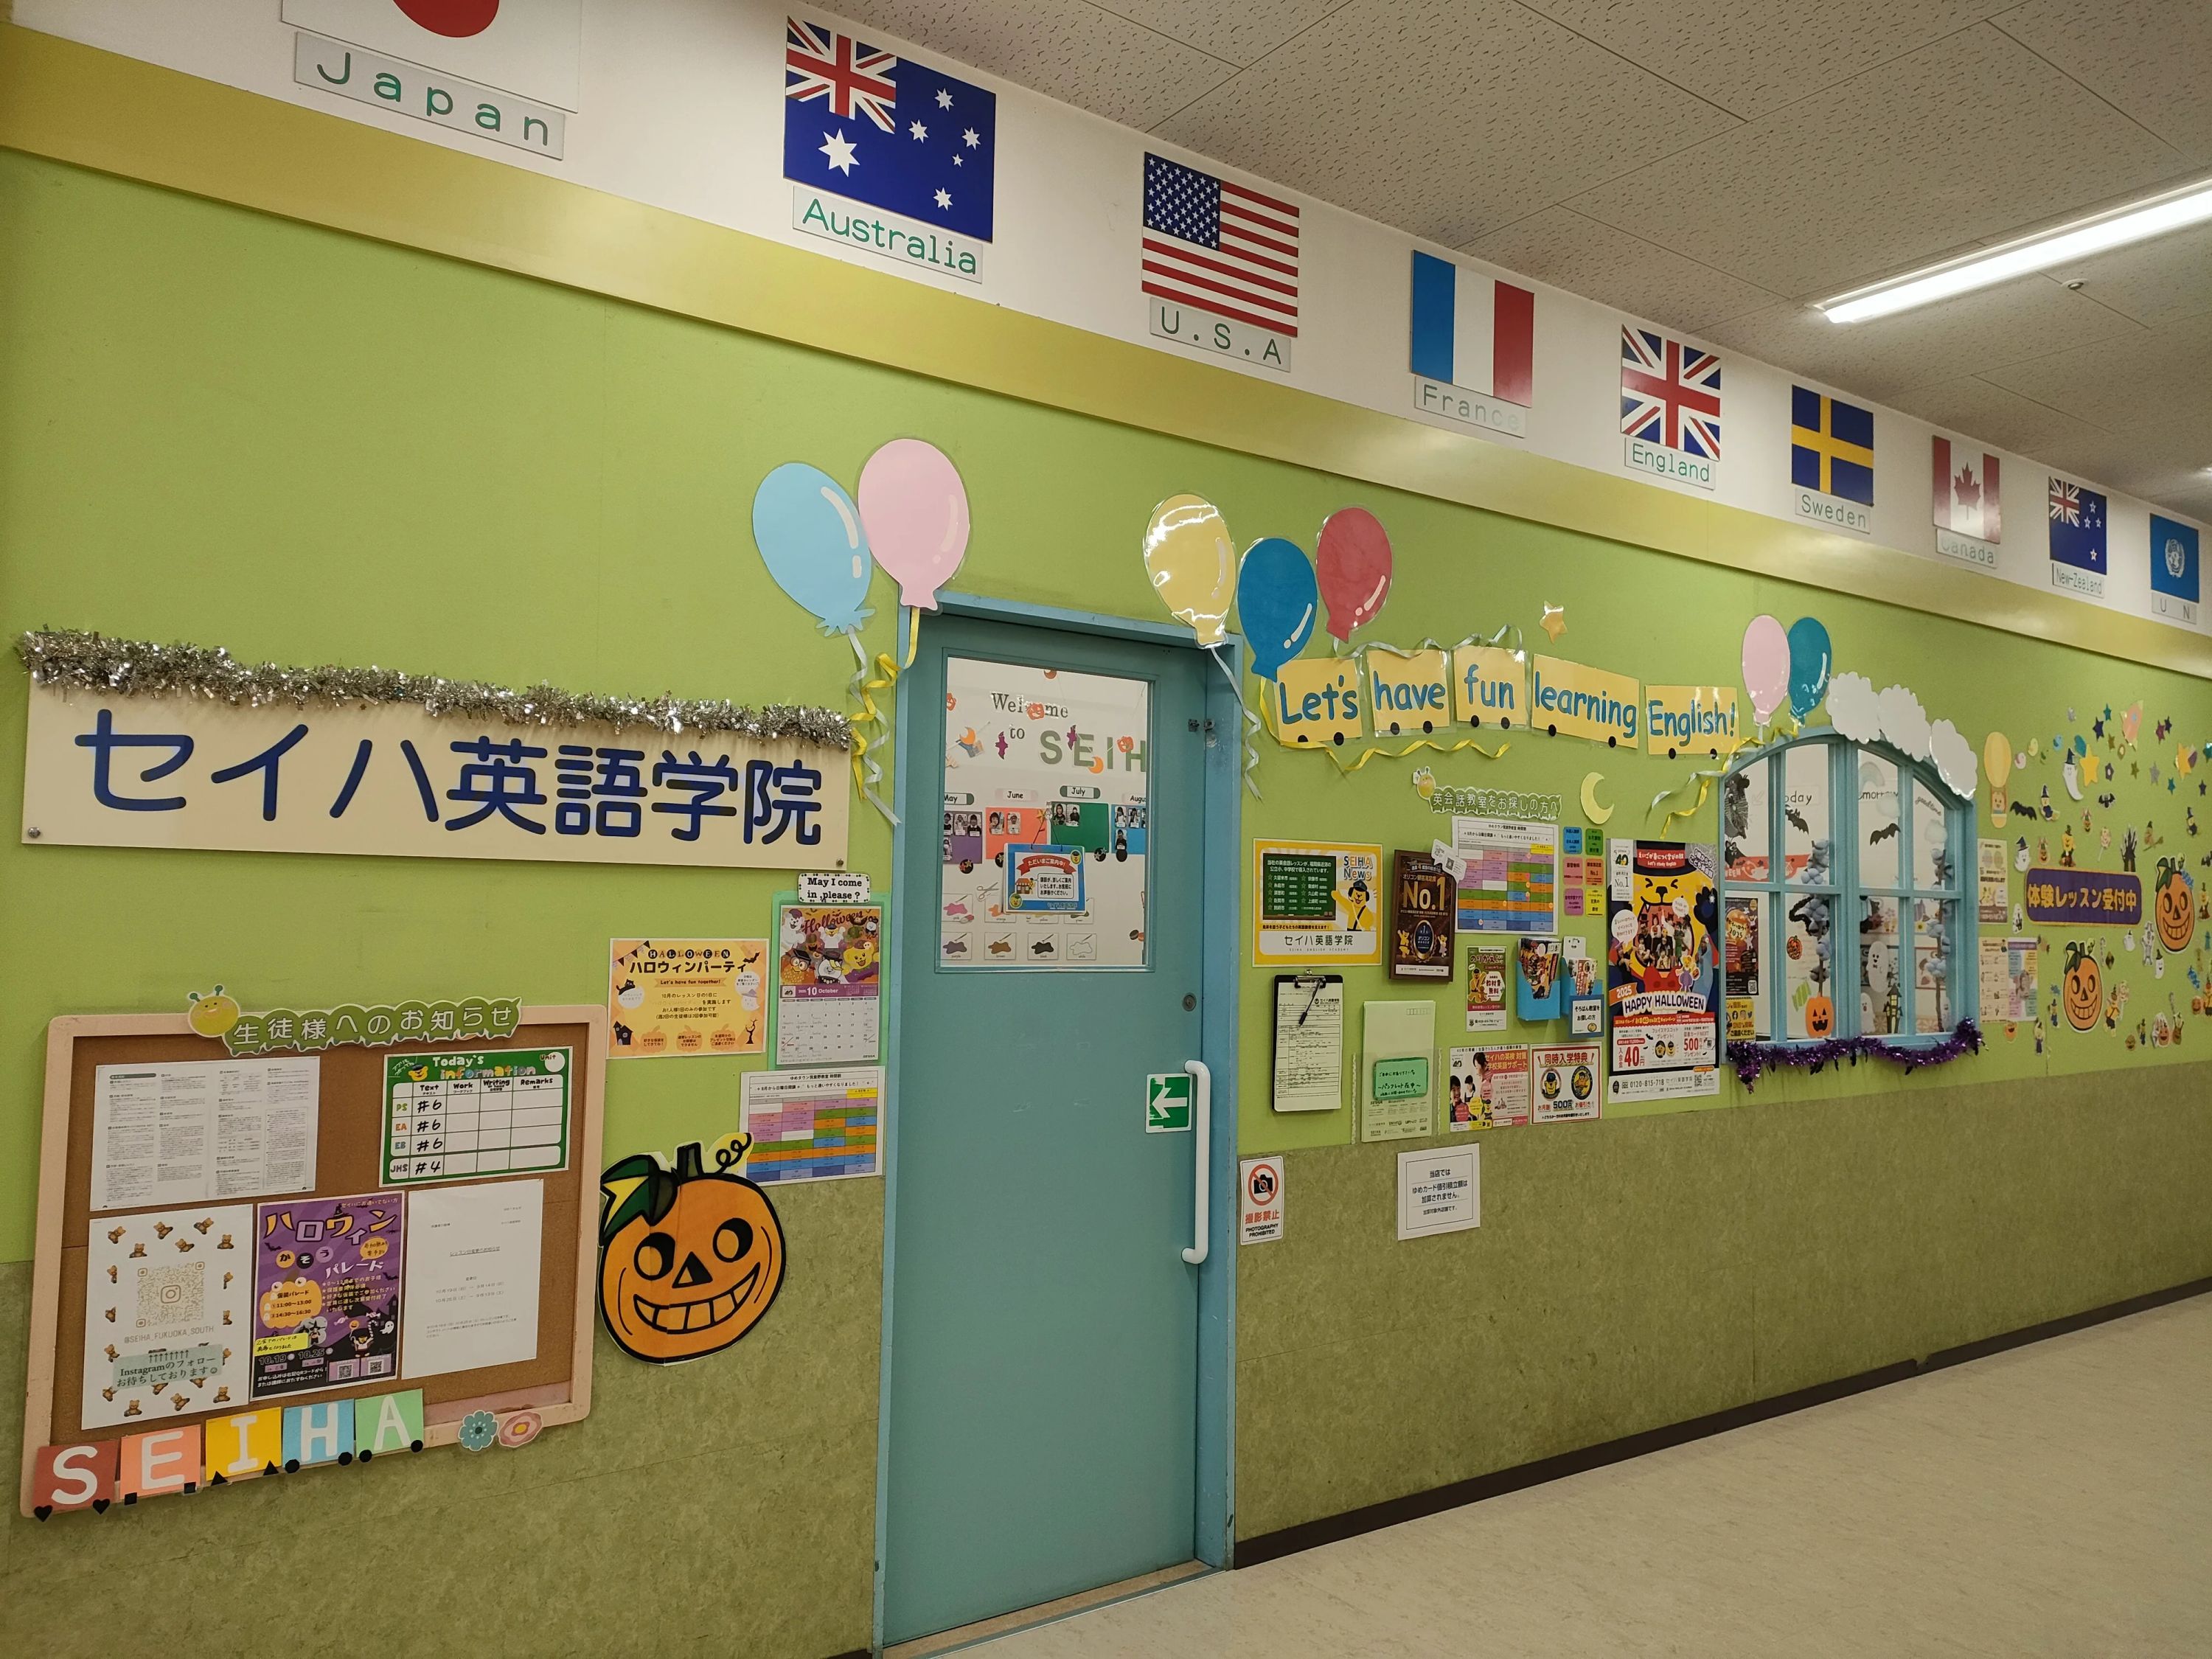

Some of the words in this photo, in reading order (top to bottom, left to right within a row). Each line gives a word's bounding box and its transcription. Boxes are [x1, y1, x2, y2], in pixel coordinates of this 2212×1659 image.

[316, 51, 549, 147] Japan
[801, 198, 977, 276] Australia
[1159, 305, 1282, 366] U.S.A
[1422, 383, 1520, 431] France
[1632, 443, 1710, 483] England
[1801, 493, 1867, 529] Sweden
[1941, 534, 1995, 566] Canada
[2056, 567, 2103, 595] New-Zealand
[990, 692, 1069, 719] Welme
[1279, 674, 1358, 726] Let's
[1374, 670, 1446, 712] have
[1464, 664, 1515, 711] fun
[1534, 670, 1638, 738] learning
[1648, 699, 1736, 747] English!
[1009, 725, 1026, 740] to
[74, 707, 823, 846] セイハ英語学院
[944, 793, 958, 804] May
[1007, 790, 1023, 799] June
[1071, 787, 1086, 797] July
[1130, 795, 1148, 804] Augus
[1433, 791, 1559, 815] 英会話教室をお探しの方へ
[1343, 855, 1374, 869] SEIHA
[1343, 868, 1372, 881] News
[807, 877, 830, 888] May
[831, 877, 836, 887] I
[838, 879, 863, 888] come
[807, 891, 817, 899] in
[1403, 875, 1446, 911] No.1
[2028, 883, 2138, 914] 体験レッスン受付中
[801, 909, 864, 933] Halloween
[1284, 934, 1354, 946] セイハ英語学院
[649, 950, 730, 959] HALLOWEEN
[629, 960, 746, 974] ハロウィンパーティ
[807, 987, 818, 996] 10
[1616, 985, 1632, 998] 2025
[1624, 995, 1652, 1014] HAPPY
[1654, 994, 1705, 1010] HALLOWEEN
[232, 1004, 512, 1046] 生徒様へのお知らせ
[1683, 1037, 1699, 1051] 500
[432, 1054, 484, 1068] Today's
[539, 1052, 557, 1062] Unit
[1544, 1053, 1588, 1064] 同時入学特典
[1624, 1046, 1640, 1067] 40
[440, 1064, 537, 1080] information
[420, 1084, 439, 1092] Text
[453, 1082, 473, 1090] Work
[483, 1078, 510, 1087] Writing
[520, 1077, 554, 1085] Remarks
[396, 1103, 408, 1112] PS
[395, 1123, 407, 1131] EA
[394, 1141, 406, 1150] EB
[390, 1163, 408, 1173] JHS
[1428, 1168, 1451, 1179] 当店では
[1411, 1179, 1468, 1194] ゆめカード値引積立額は
[1421, 1192, 1460, 1204] 加算されません。
[1245, 1209, 1280, 1224] 撮影禁止
[262, 1209, 397, 1246] ハロウィン
[1245, 1222, 1279, 1233] PHOTOGRAPHY
[1248, 1229, 1276, 1238] PROHIBITED
[325, 1259, 384, 1279] パレード
[119, 1356, 216, 1377] Instagramのフォロー
[116, 1366, 210, 1388] お待ちしております
[49, 1394, 413, 1506] SEIHA
